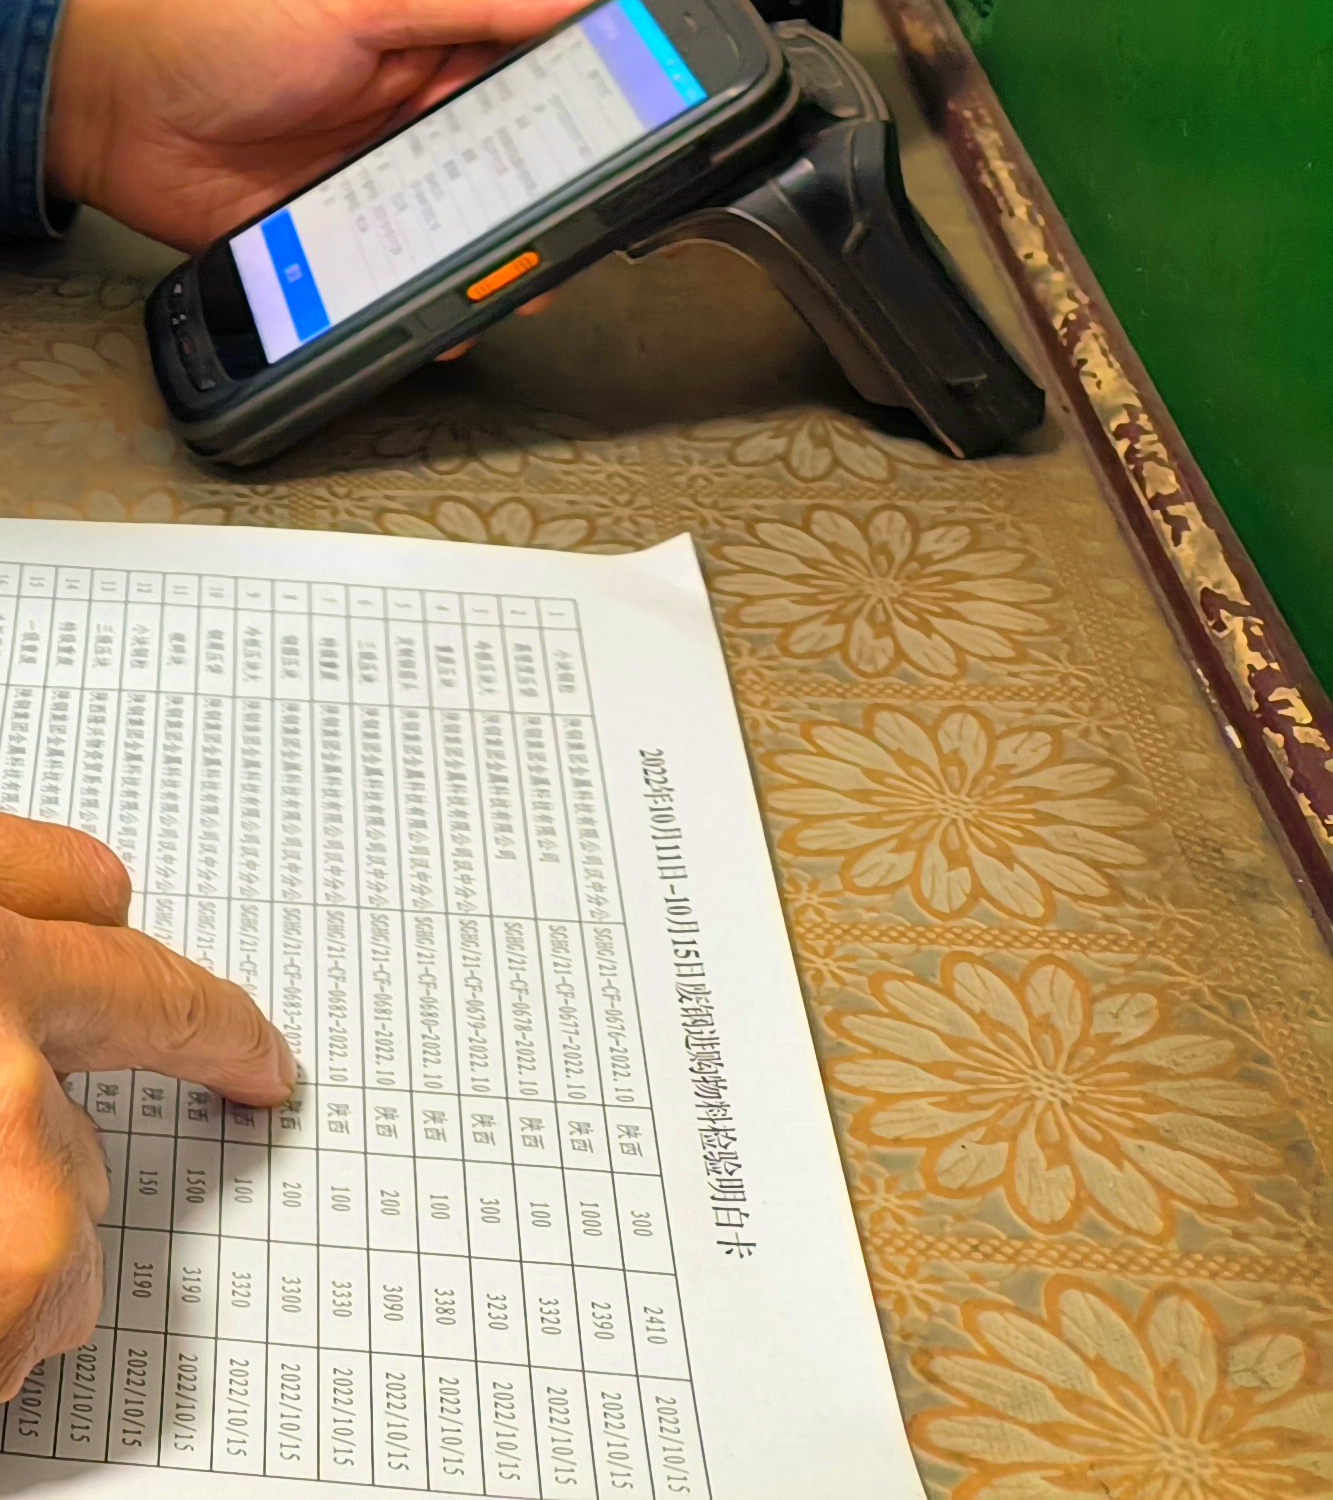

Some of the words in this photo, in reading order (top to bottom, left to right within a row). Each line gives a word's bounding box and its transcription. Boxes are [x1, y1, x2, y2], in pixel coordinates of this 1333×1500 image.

[115, 693, 147, 872] 陕钢集团金属科技有限公司汉中
[95, 1083, 121, 1115] 陕西
[141, 1087, 167, 1120] 陕西
[187, 1091, 211, 1123] 陕西
[231, 1106, 255, 1129] 西
[327, 1103, 351, 1134] 陕西
[374, 1106, 399, 1139] 陕西
[422, 1110, 448, 1142] 陕西
[471, 1114, 496, 1146] 陕西
[519, 1117, 545, 1149] 陕西
[568, 1121, 594, 1153] 陕西
[617, 1124, 643, 1157] 陕西
[138, 1170, 158, 1195] 150
[186, 1169, 207, 1203] 1500
[233, 1178, 253, 1203] 100
[282, 1182, 301, 1207] 200
[331, 1186, 351, 1211] 100
[380, 1190, 400, 1215] 200
[429, 1194, 450, 1219] 100
[480, 1198, 501, 1223] 300
[530, 1202, 551, 1227] 100
[580, 1201, 603, 1236] 1000
[631, 1211, 653, 1236] 300
[132, 1262, 153, 1298] 3190
[181, 1267, 202, 1303] 3190
[231, 1272, 251, 1308] 3320
[281, 1277, 301, 1313] 3300
[332, 1281, 352, 1317] 3330
[383, 1285, 404, 1321] 3090
[434, 1288, 456, 1325] 3380
[486, 1293, 509, 1330] 3230
[539, 1298, 561, 1335] 3320
[591, 1302, 615, 1339] 2390
[643, 1306, 668, 1344] 2410
[69, 1344, 98, 1443] 2022/10/15
[122, 1349, 148, 1447] 2022/10/15
[173, 1353, 198, 1451] 2022/10/15
[225, 1359, 250, 1456] 2022/10/15
[278, 1363, 303, 1461] 2022/10/15
[331, 1368, 356, 1466] 2022/10/15
[385, 1372, 410, 1470] 2022/10/15
[438, 1377, 464, 1475] 2022/10/15
[493, 1382, 521, 1480] 2022/10/15
[547, 1386, 577, 1484] 2022/10/15
[601, 1391, 633, 1489] 2022/10/15
[655, 1396, 690, 1493] 2022/10/15
